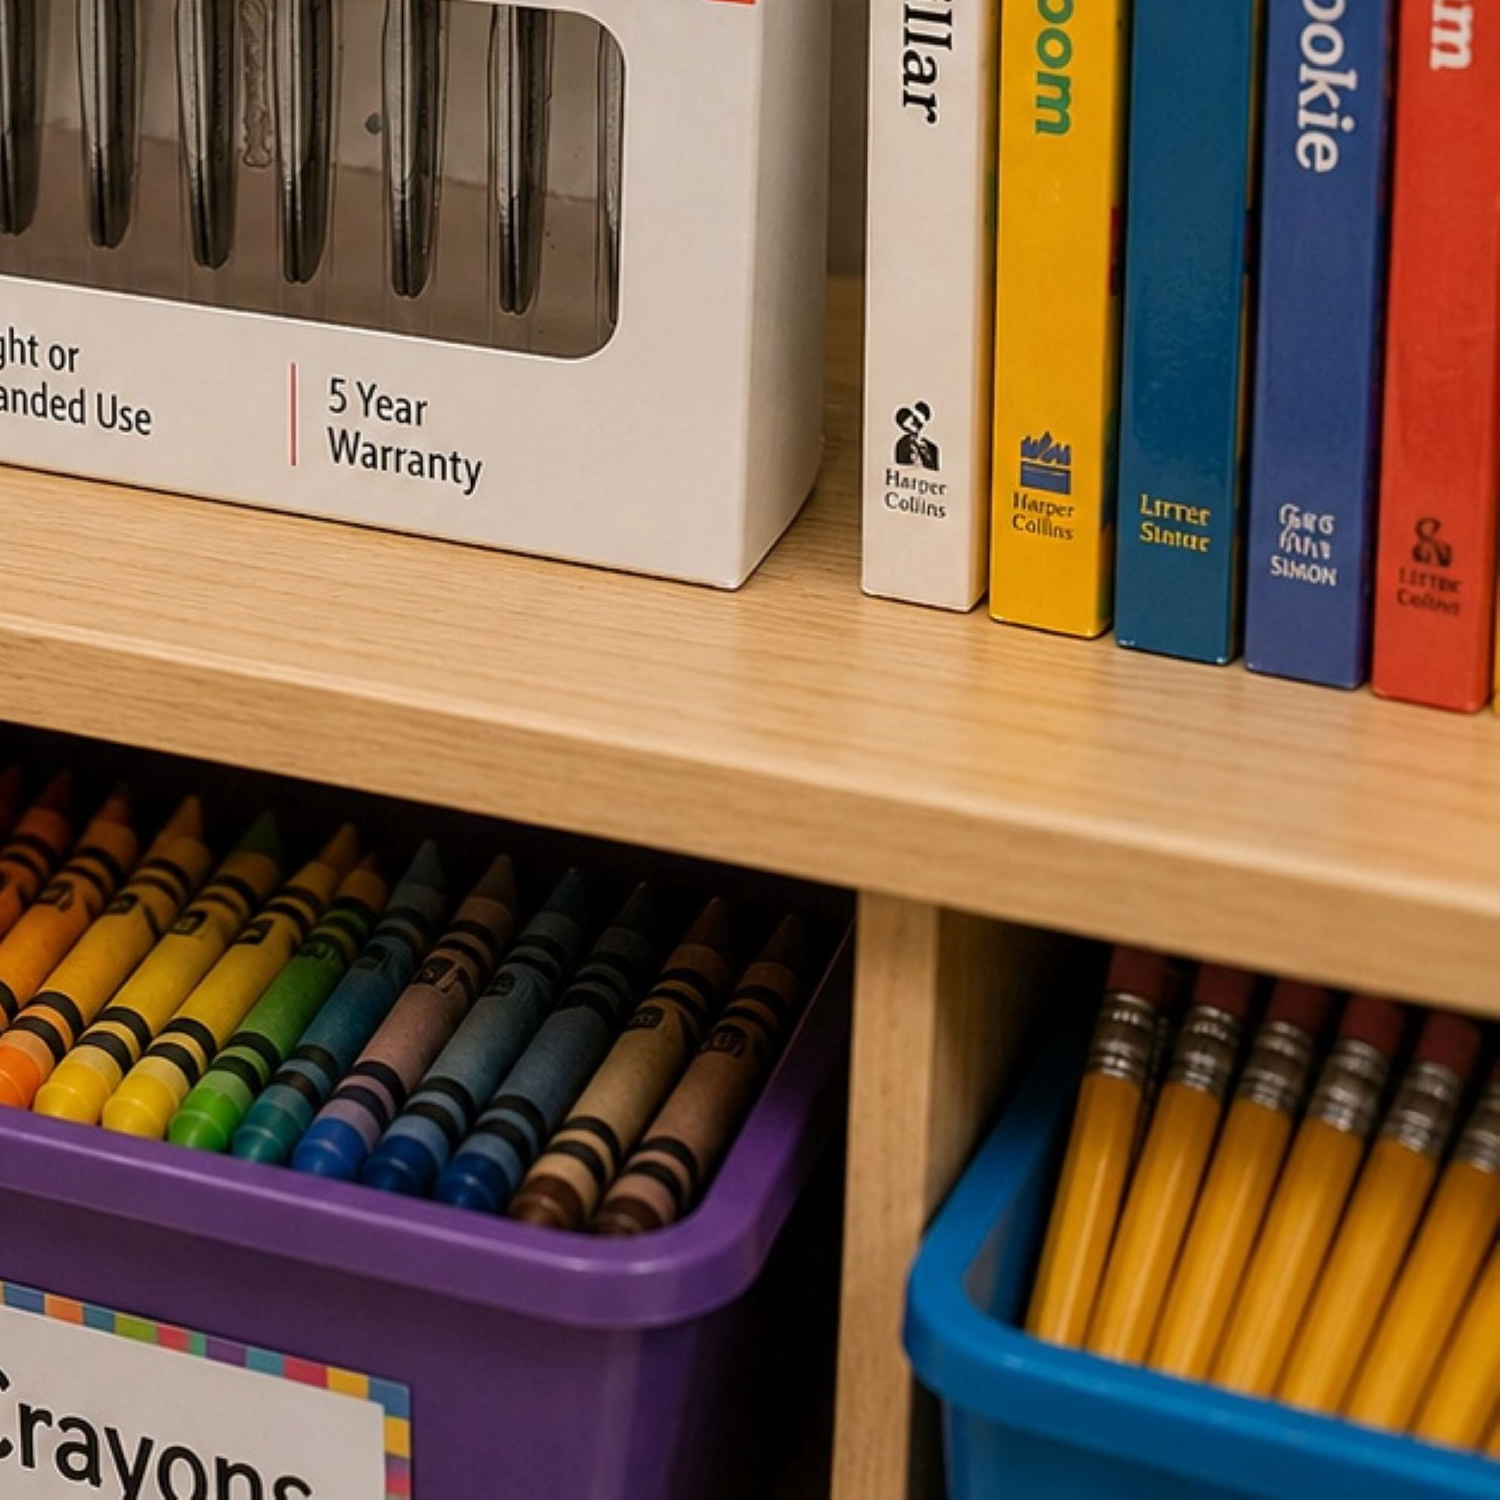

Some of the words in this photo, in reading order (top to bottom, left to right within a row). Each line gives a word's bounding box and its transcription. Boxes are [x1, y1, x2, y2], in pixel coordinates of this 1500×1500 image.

[48, 343, 80, 373] or
[96, 392, 152, 436] Use
[328, 377, 348, 414] 5
[356, 381, 429, 426] Year
[328, 427, 483, 495] Warranty
